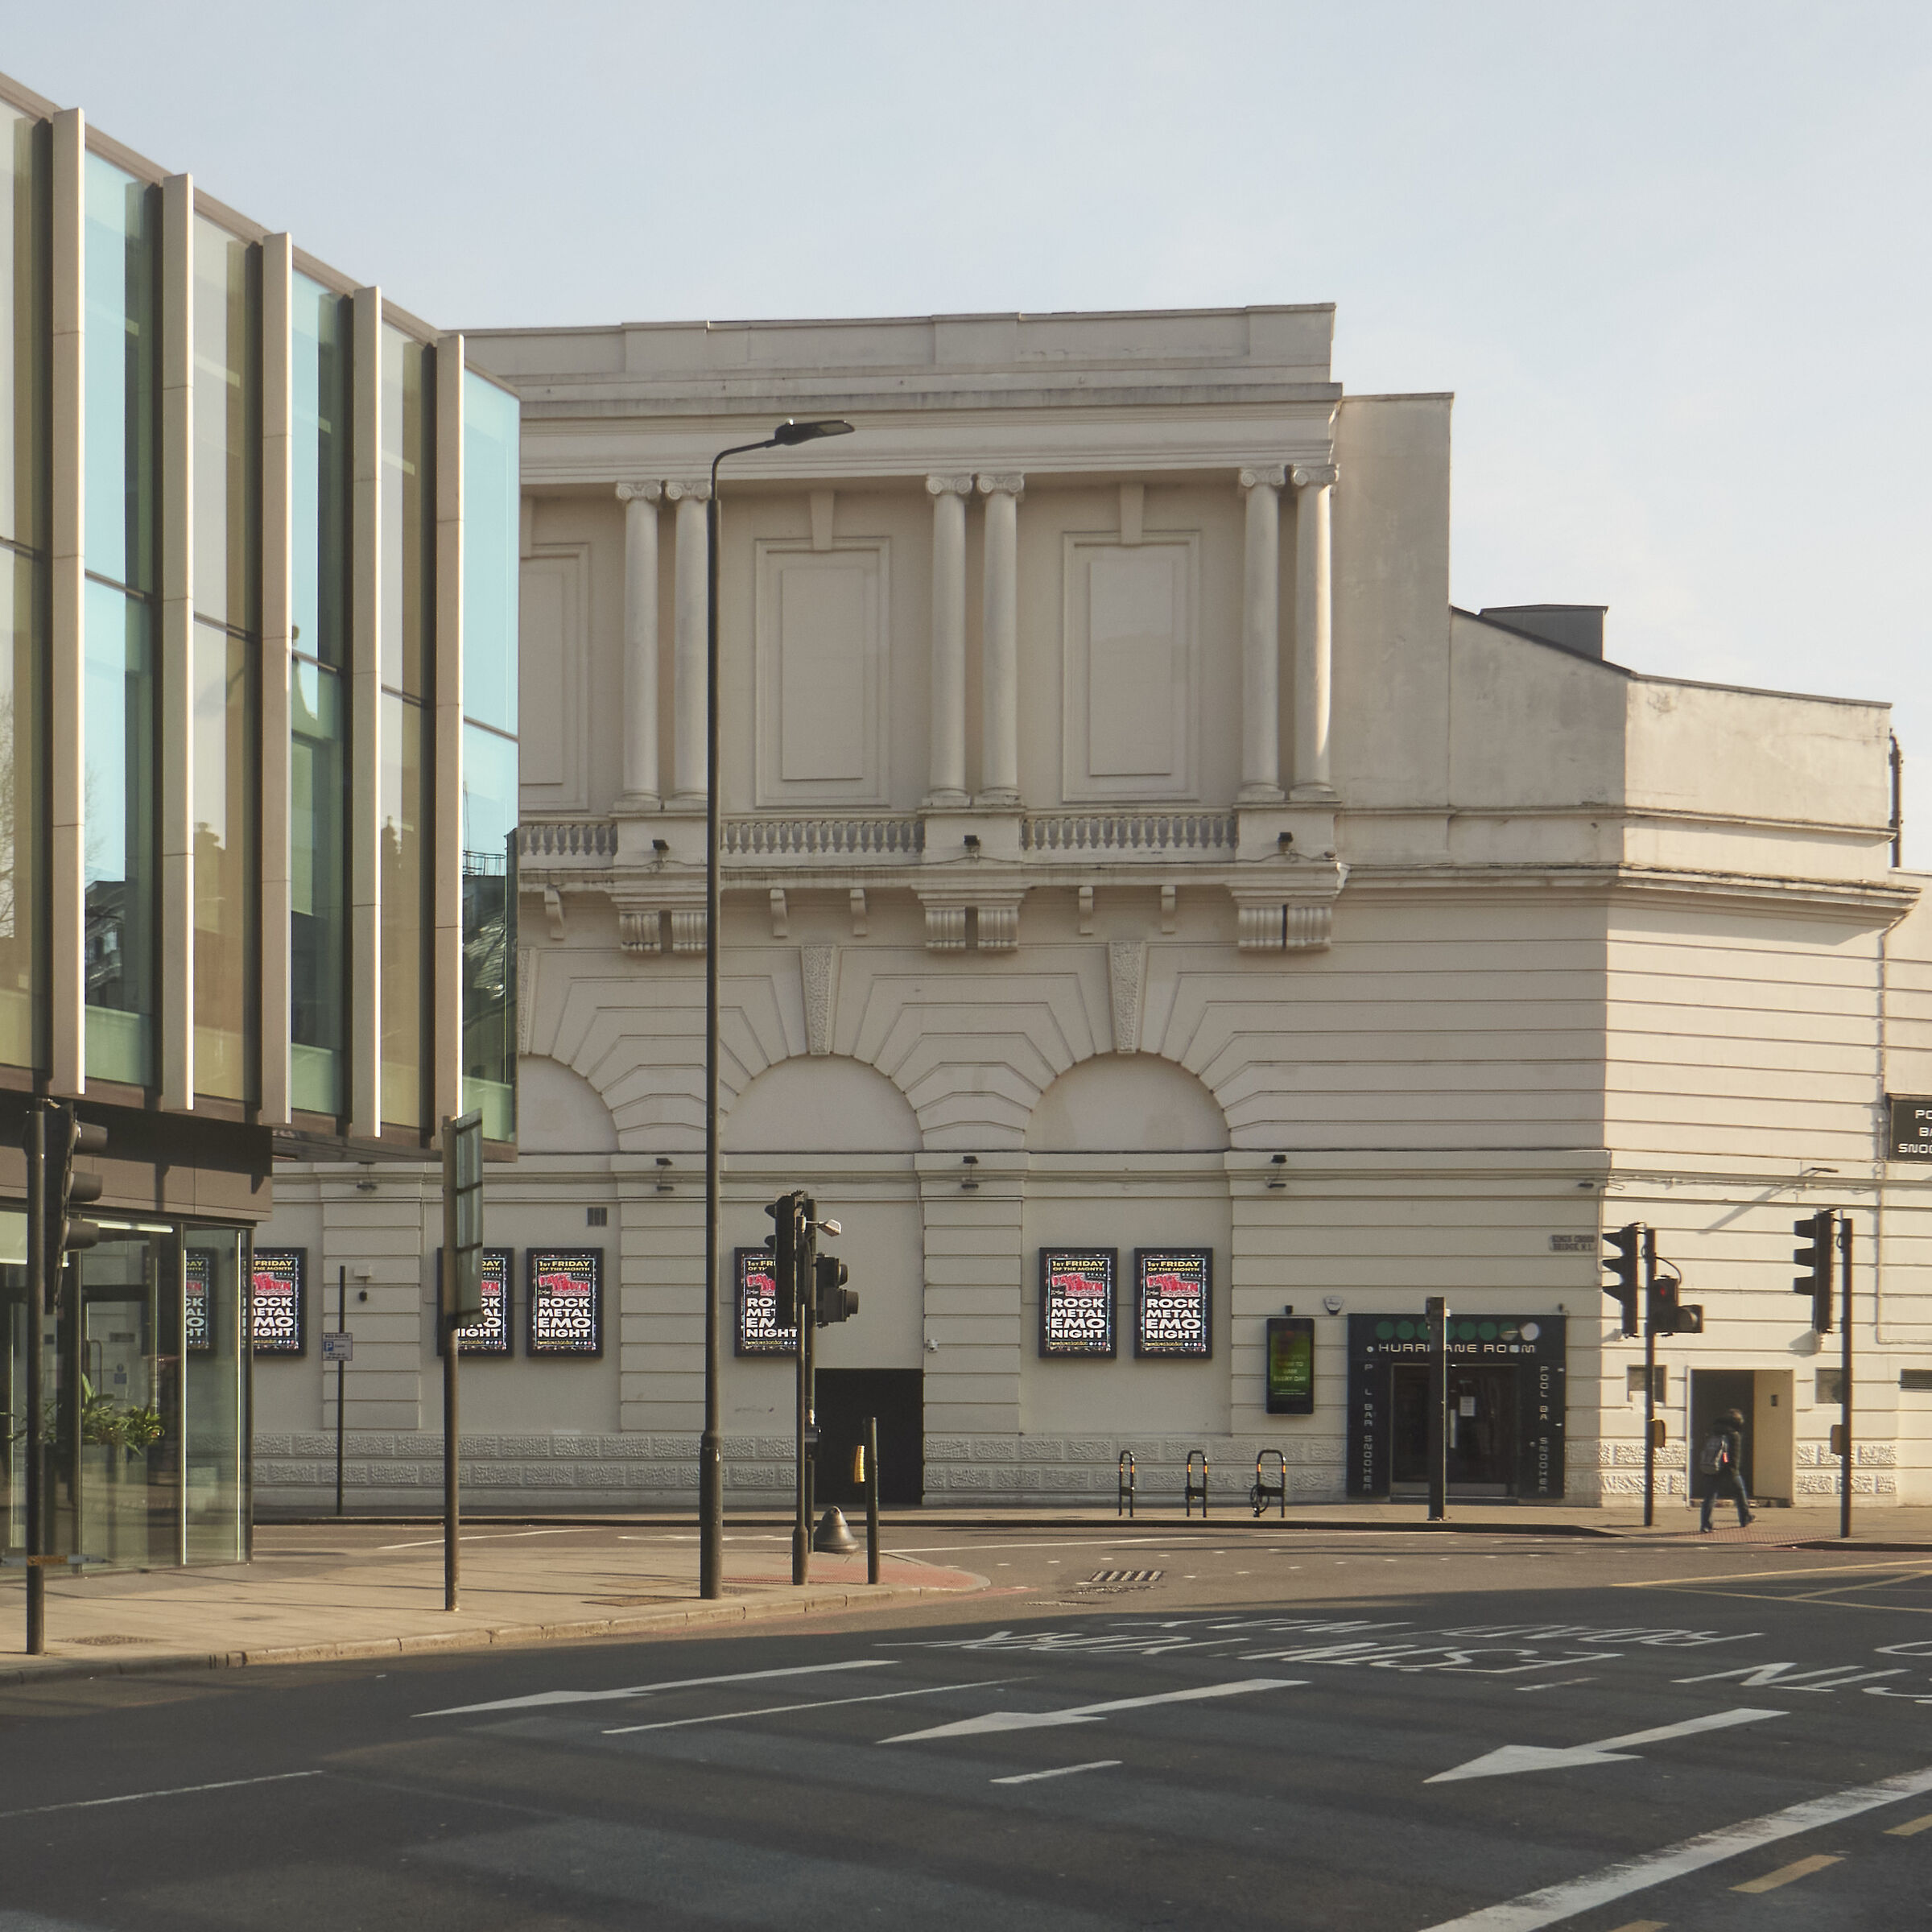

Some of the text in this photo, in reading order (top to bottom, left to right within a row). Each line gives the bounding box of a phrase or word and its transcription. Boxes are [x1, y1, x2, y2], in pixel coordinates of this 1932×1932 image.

[539, 1298, 590, 1307] ROCK
[747, 1298, 776, 1307] RO
[1052, 1298, 1104, 1307] ROCK
[1146, 1299, 1200, 1308] ROCK
[539, 1309, 592, 1317] METAL
[1051, 1309, 1106, 1318] METAL
[1146, 1310, 1201, 1318] METAL
[539, 1318, 591, 1328] EMO
[747, 1318, 775, 1328] EM
[1051, 1319, 1105, 1328] EMO
[1146, 1319, 1201, 1329] EMO
[539, 1328, 591, 1338] NIGHT
[746, 1328, 797, 1338] NIGHT
[1051, 1330, 1105, 1338] NIGHT
[1146, 1330, 1201, 1339] NIGHT
[1378, 1344, 1477, 1353] HURRIANE
[1440, 1624, 1765, 1646] ROAD
